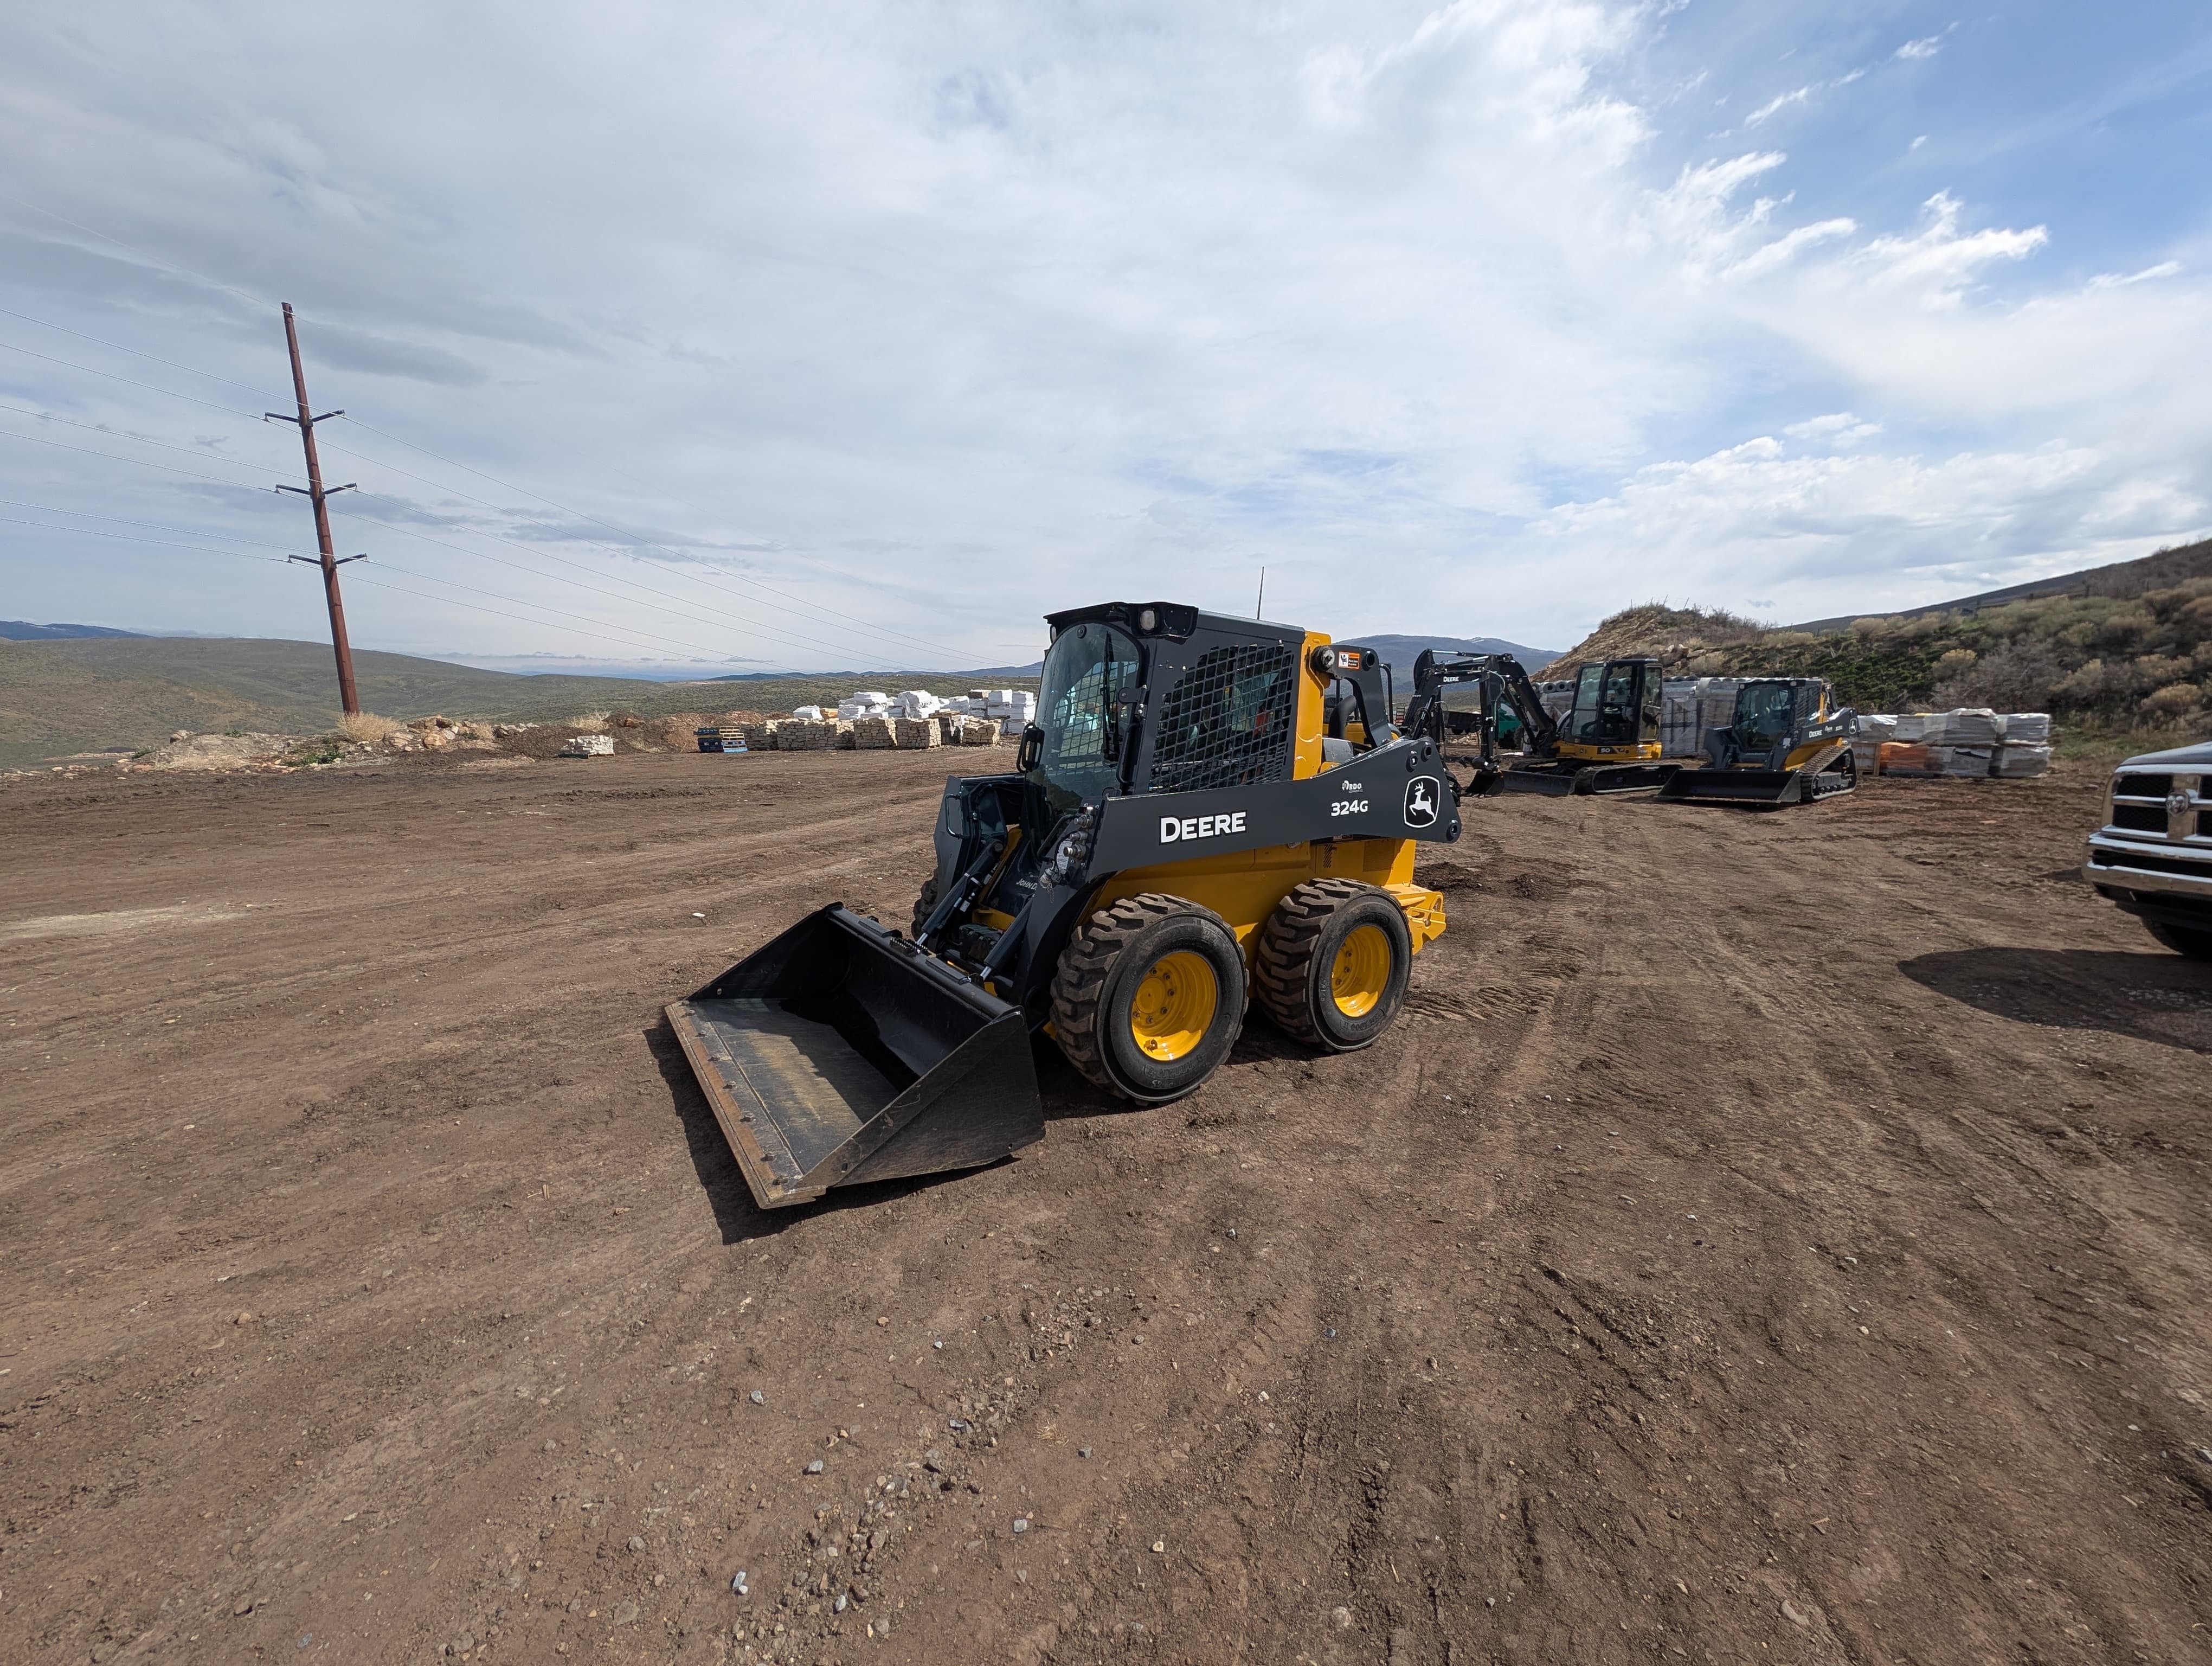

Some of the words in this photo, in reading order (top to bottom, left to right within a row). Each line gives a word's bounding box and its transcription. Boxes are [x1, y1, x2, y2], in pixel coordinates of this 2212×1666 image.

[1331, 800, 1368, 816] 324G
[1161, 812, 1246, 843] DEERE
[1016, 879, 1033, 888] JOHN
